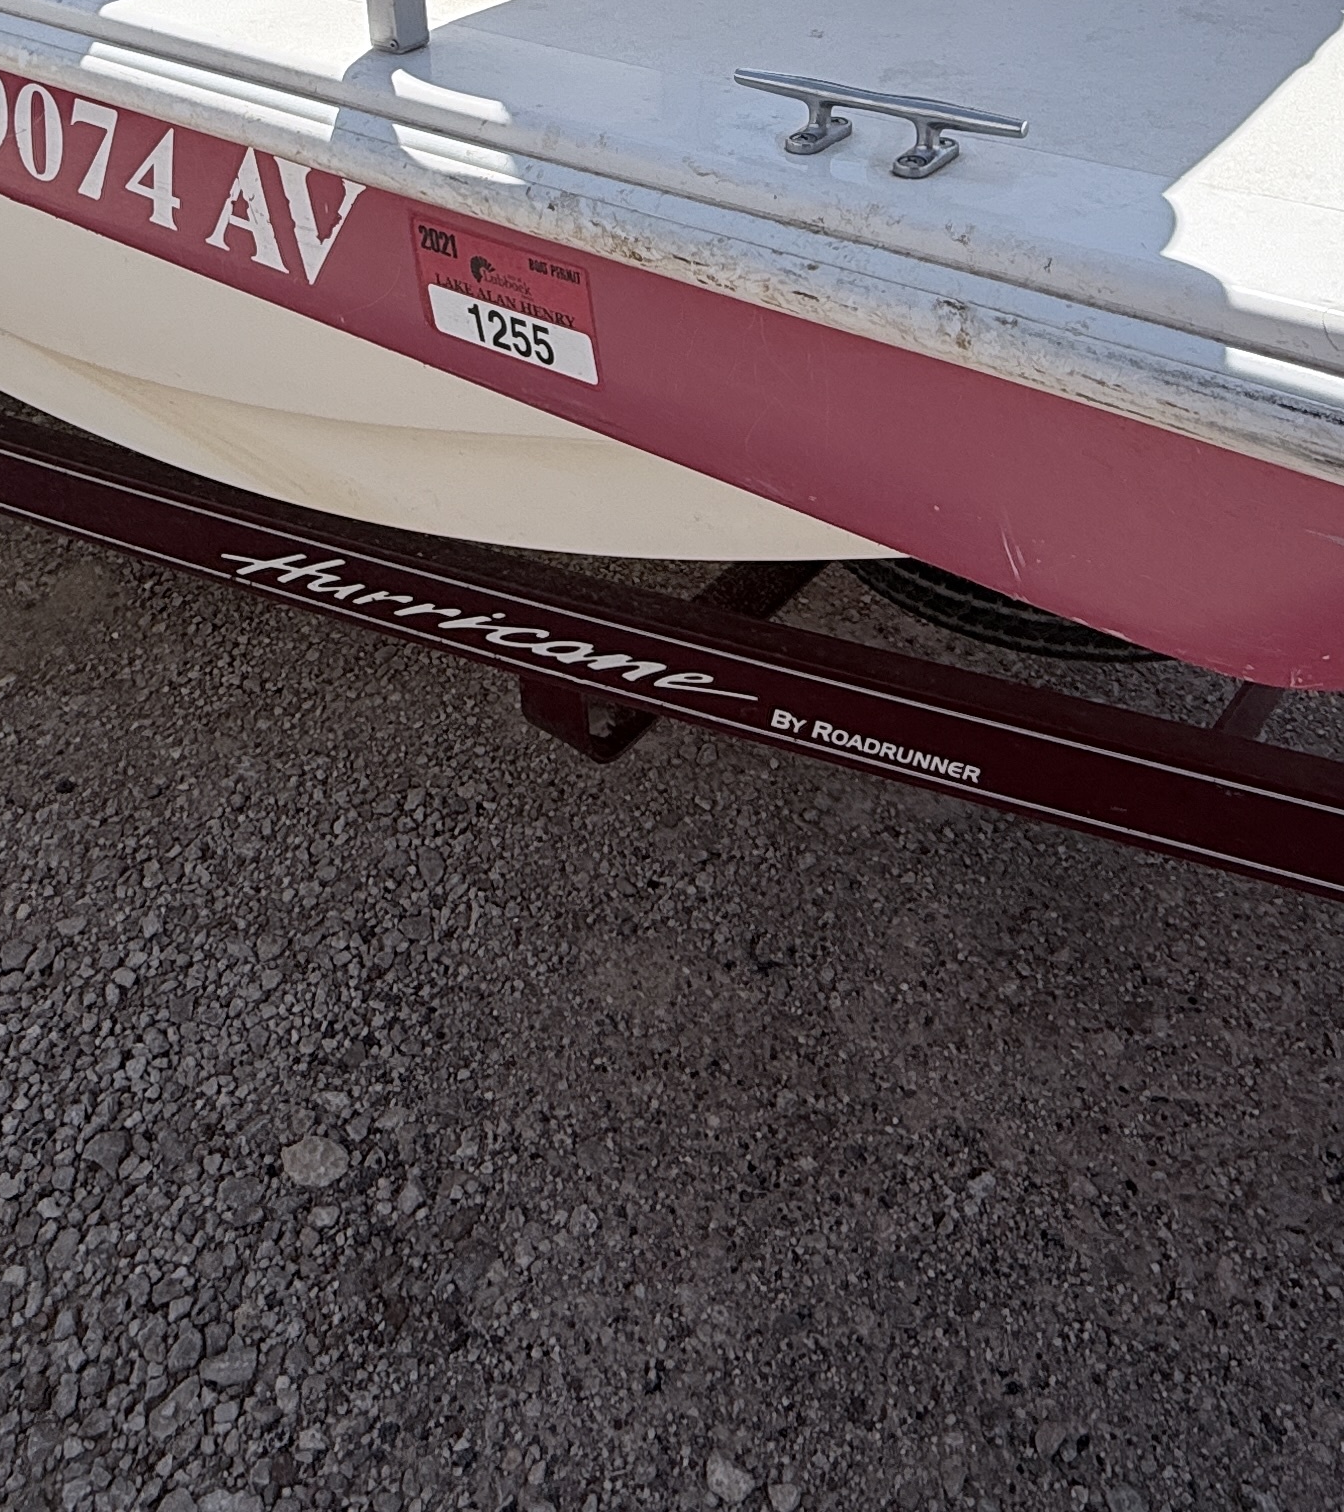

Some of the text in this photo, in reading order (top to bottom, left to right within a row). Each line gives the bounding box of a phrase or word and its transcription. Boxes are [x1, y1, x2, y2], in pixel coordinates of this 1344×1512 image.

[204, 146, 367, 285] AV
[418, 224, 458, 259] 2021
[435, 272, 576, 329] LAKE ALAN HENRY
[481, 268, 533, 297] Lubbock
[467, 303, 555, 366] 1255
[220, 552, 759, 701] Hurricane
